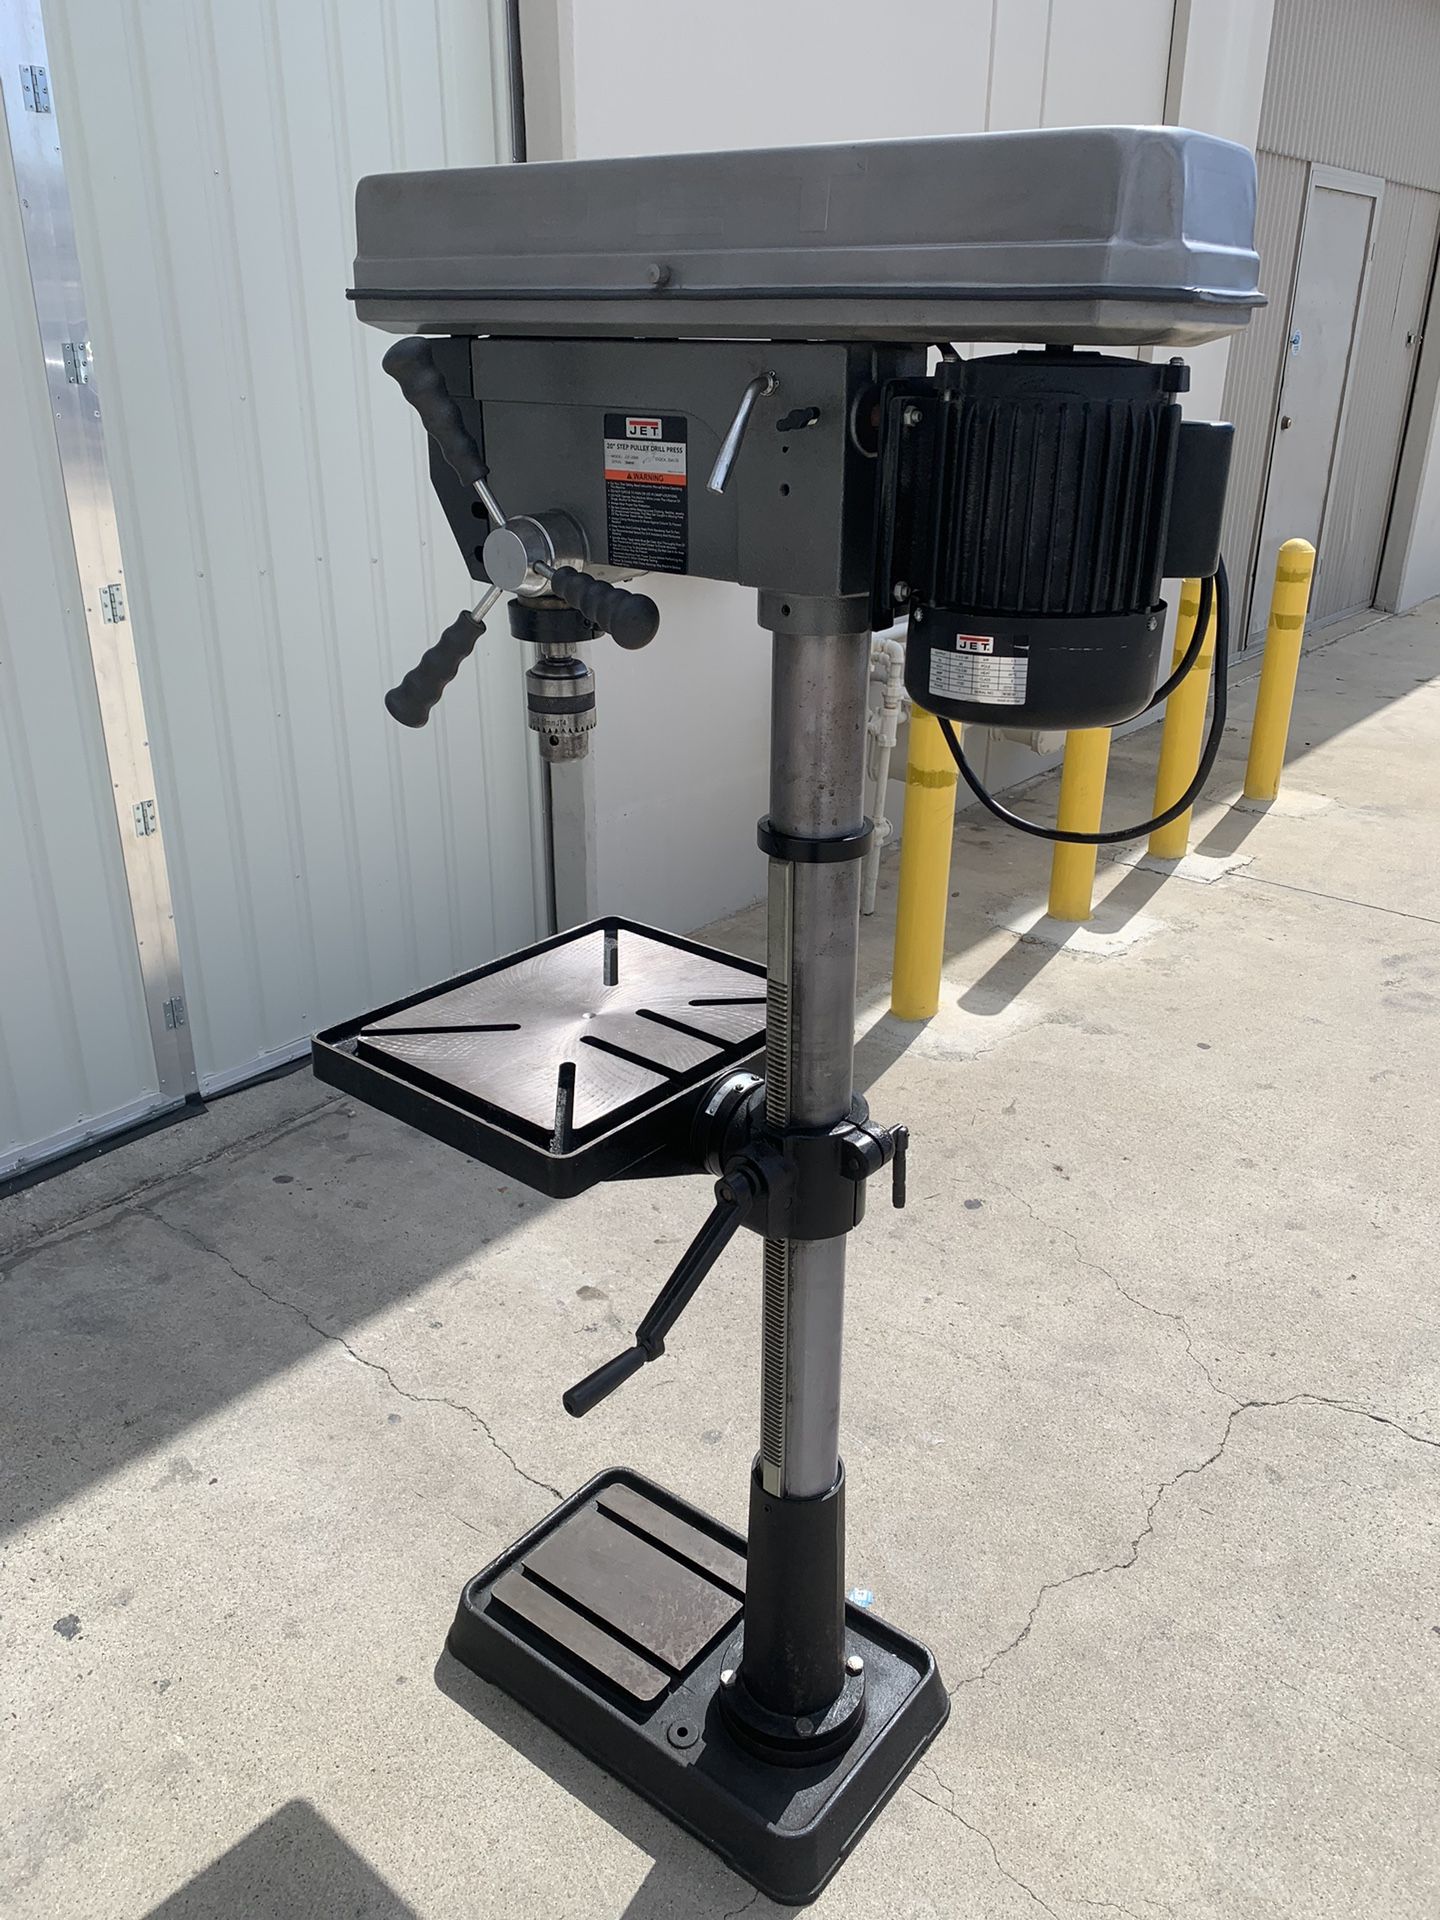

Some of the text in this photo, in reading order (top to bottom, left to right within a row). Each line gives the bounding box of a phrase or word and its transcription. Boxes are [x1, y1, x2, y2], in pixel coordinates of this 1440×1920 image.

[629, 425, 659, 437] JET
[606, 442, 683, 454] 20" STEP PULLEY DRILL PRESS
[633, 473, 664, 482] WARNING
[959, 641, 990, 651] JET
